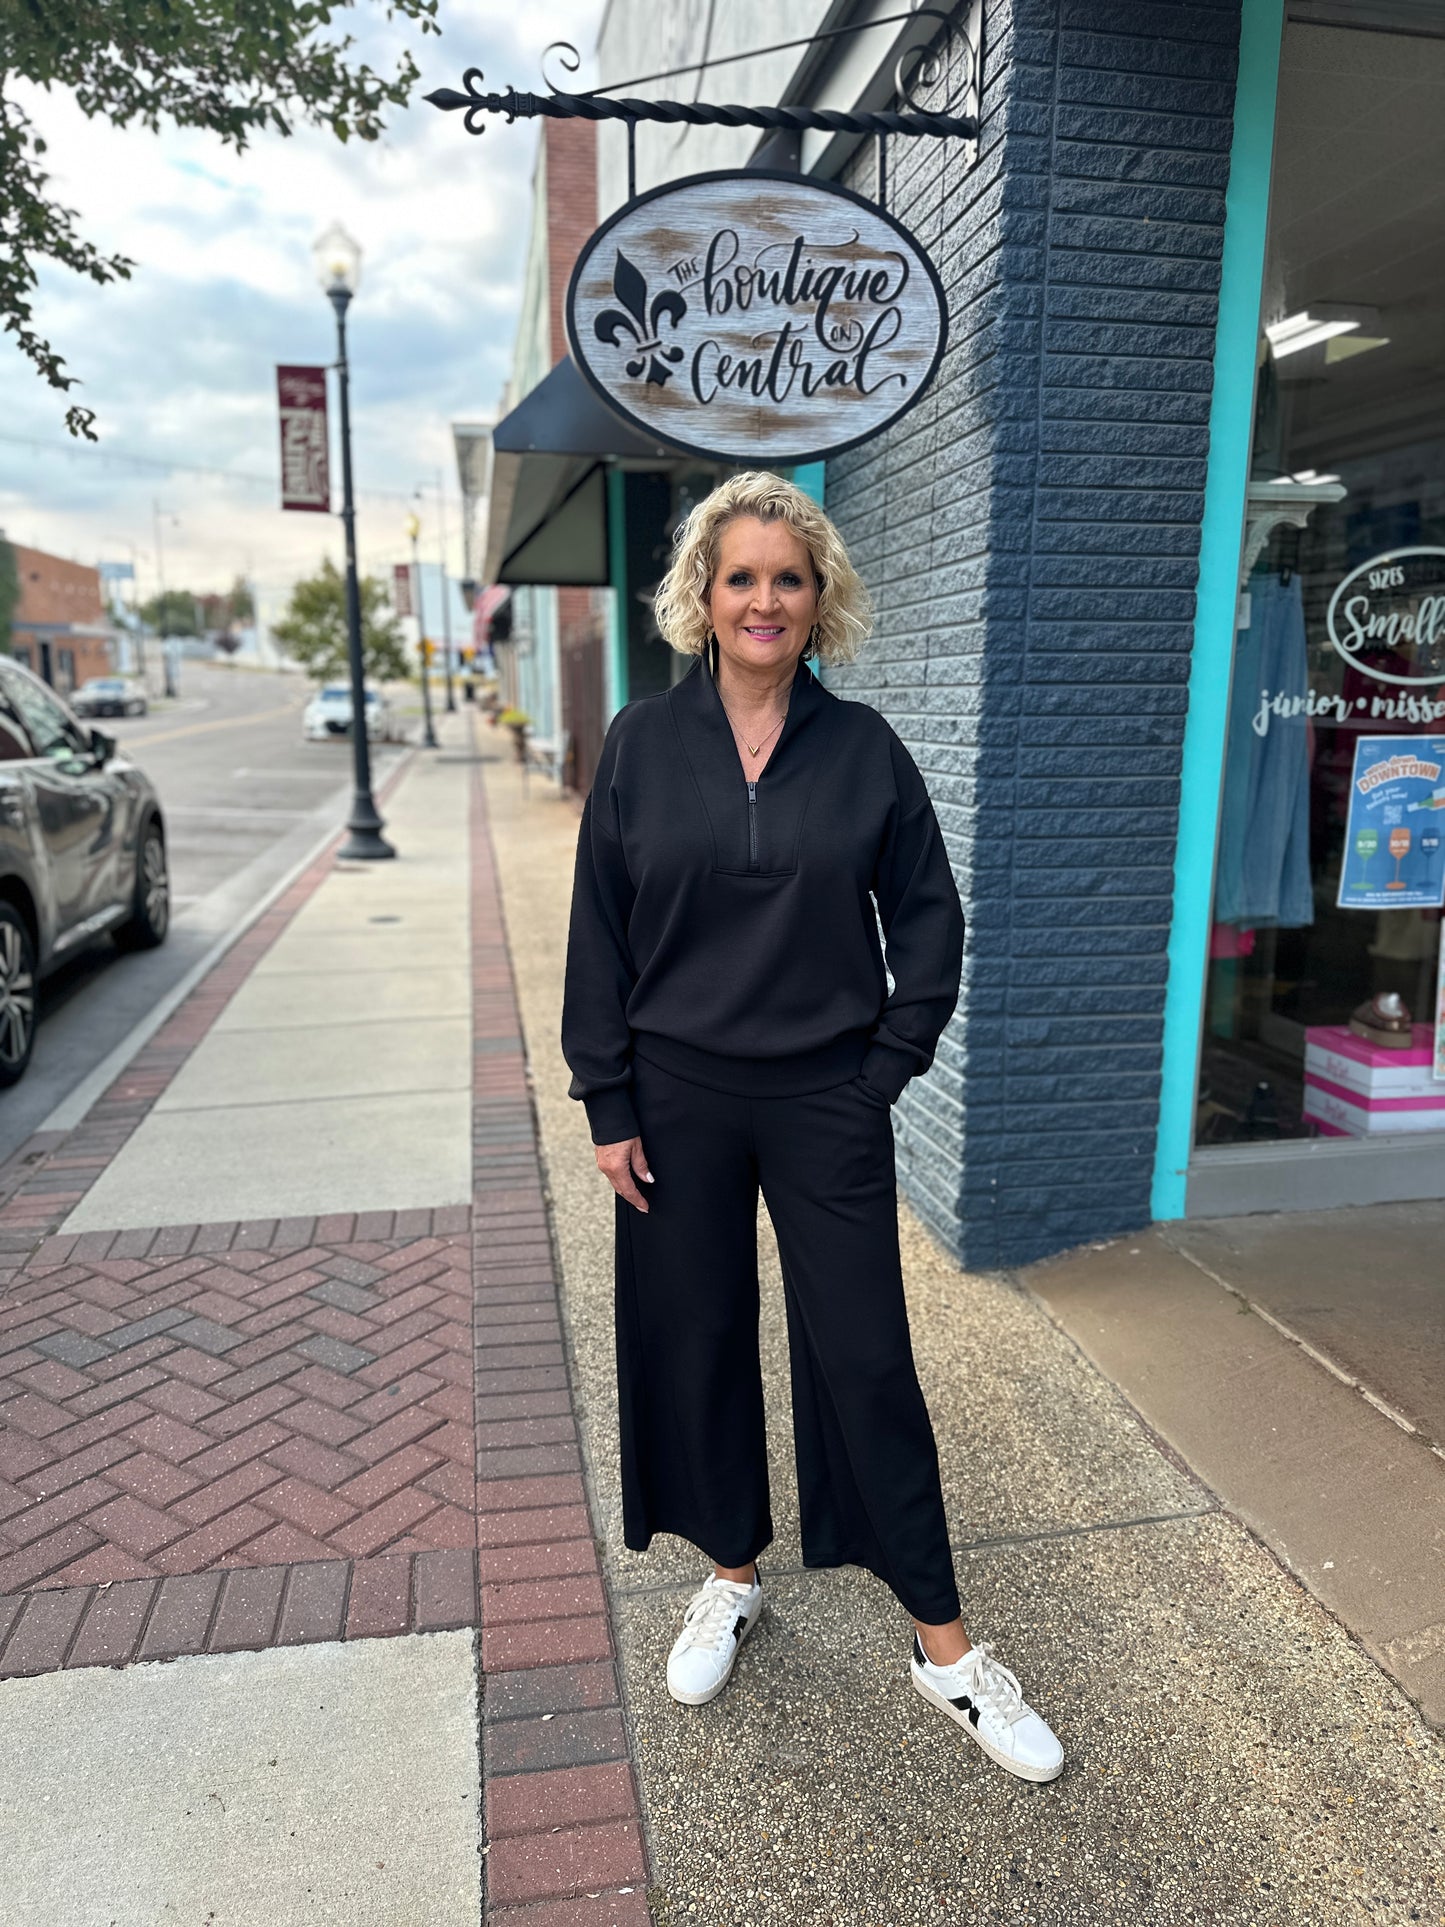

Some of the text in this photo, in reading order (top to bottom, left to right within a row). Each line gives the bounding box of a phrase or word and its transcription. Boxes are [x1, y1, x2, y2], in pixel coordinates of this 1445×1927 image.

[667, 229, 909, 354] THE boutique
[830, 322, 853, 342] ON
[692, 306, 907, 404] Central
[1368, 566, 1405, 590] SIZES
[1358, 763, 1439, 793] DOWNTOWN
